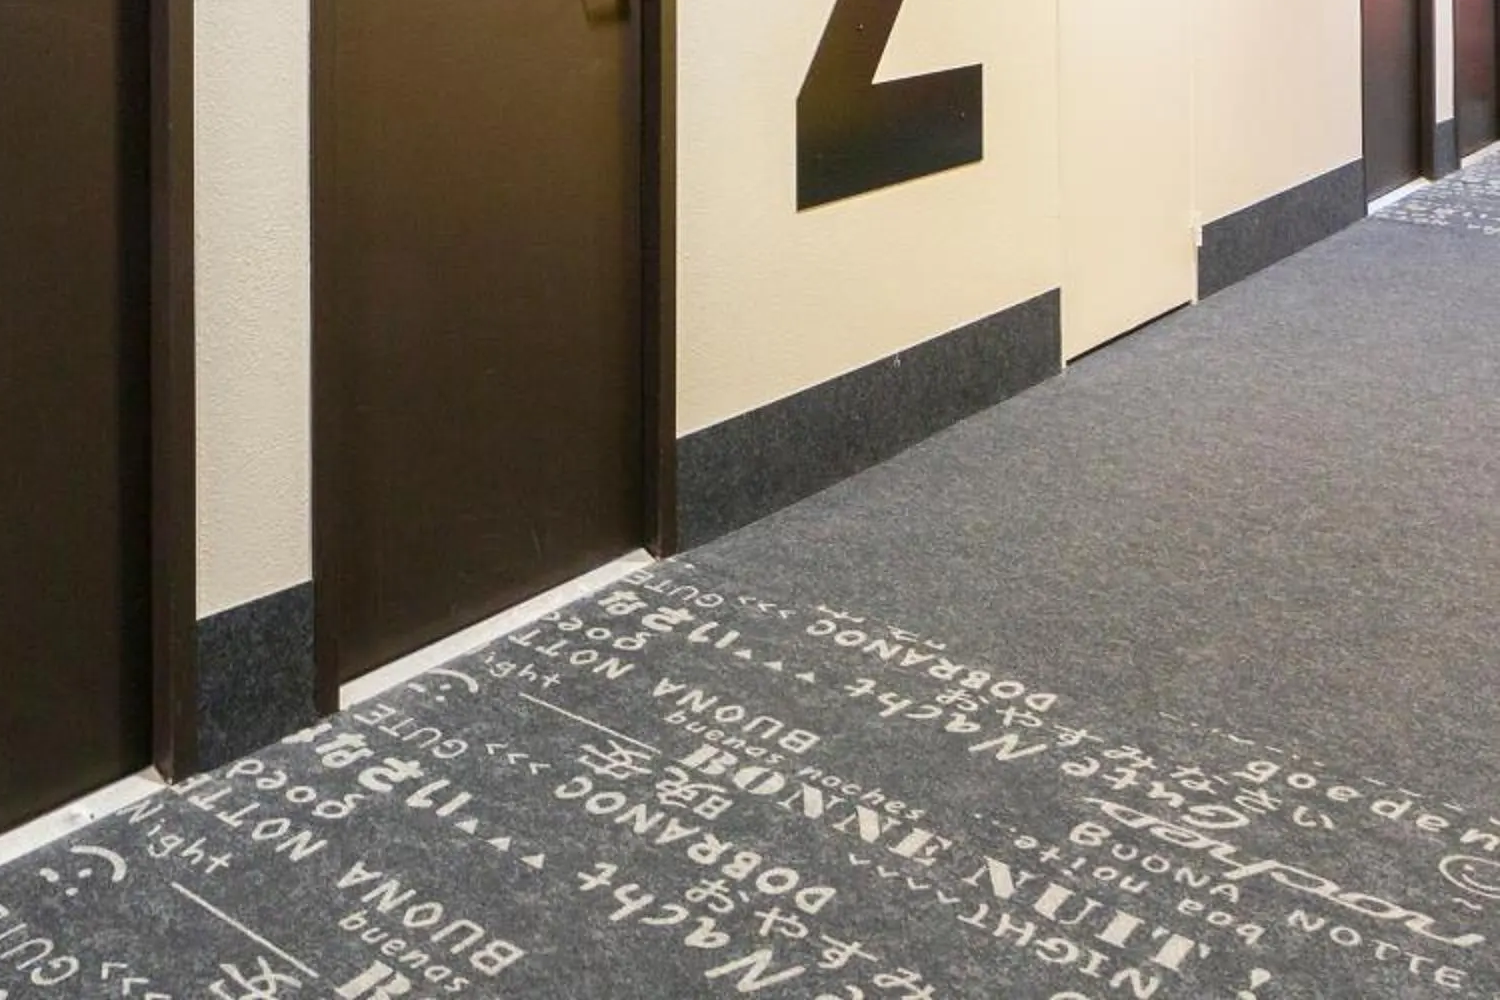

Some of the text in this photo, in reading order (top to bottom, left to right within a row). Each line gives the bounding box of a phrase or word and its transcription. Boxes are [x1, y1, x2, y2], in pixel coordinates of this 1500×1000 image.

[484, 651, 560, 687] ight
[807, 620, 1057, 711] DOBRANOC
[353, 704, 467, 758] GUTE
[654, 678, 820, 753] BUONA
[845, 679, 1249, 828] Gute Nacht
[936, 689, 1334, 829] おやすみなさい
[665, 711, 924, 820] buenas noches
[1233, 761, 1500, 851] goeden
[555, 777, 836, 913] DOBRANOC
[679, 744, 951, 866] BONNE
[963, 856, 1210, 971] NUIT
[1082, 798, 1484, 946] noches
[337, 862, 524, 975] BUONA
[339, 910, 469, 991] buenas
[578, 863, 805, 992] Nacht
[958, 904, 1159, 1000] NIGHT
[1177, 898, 1264, 945] boa
[1287, 910, 1465, 988] NOTTE
